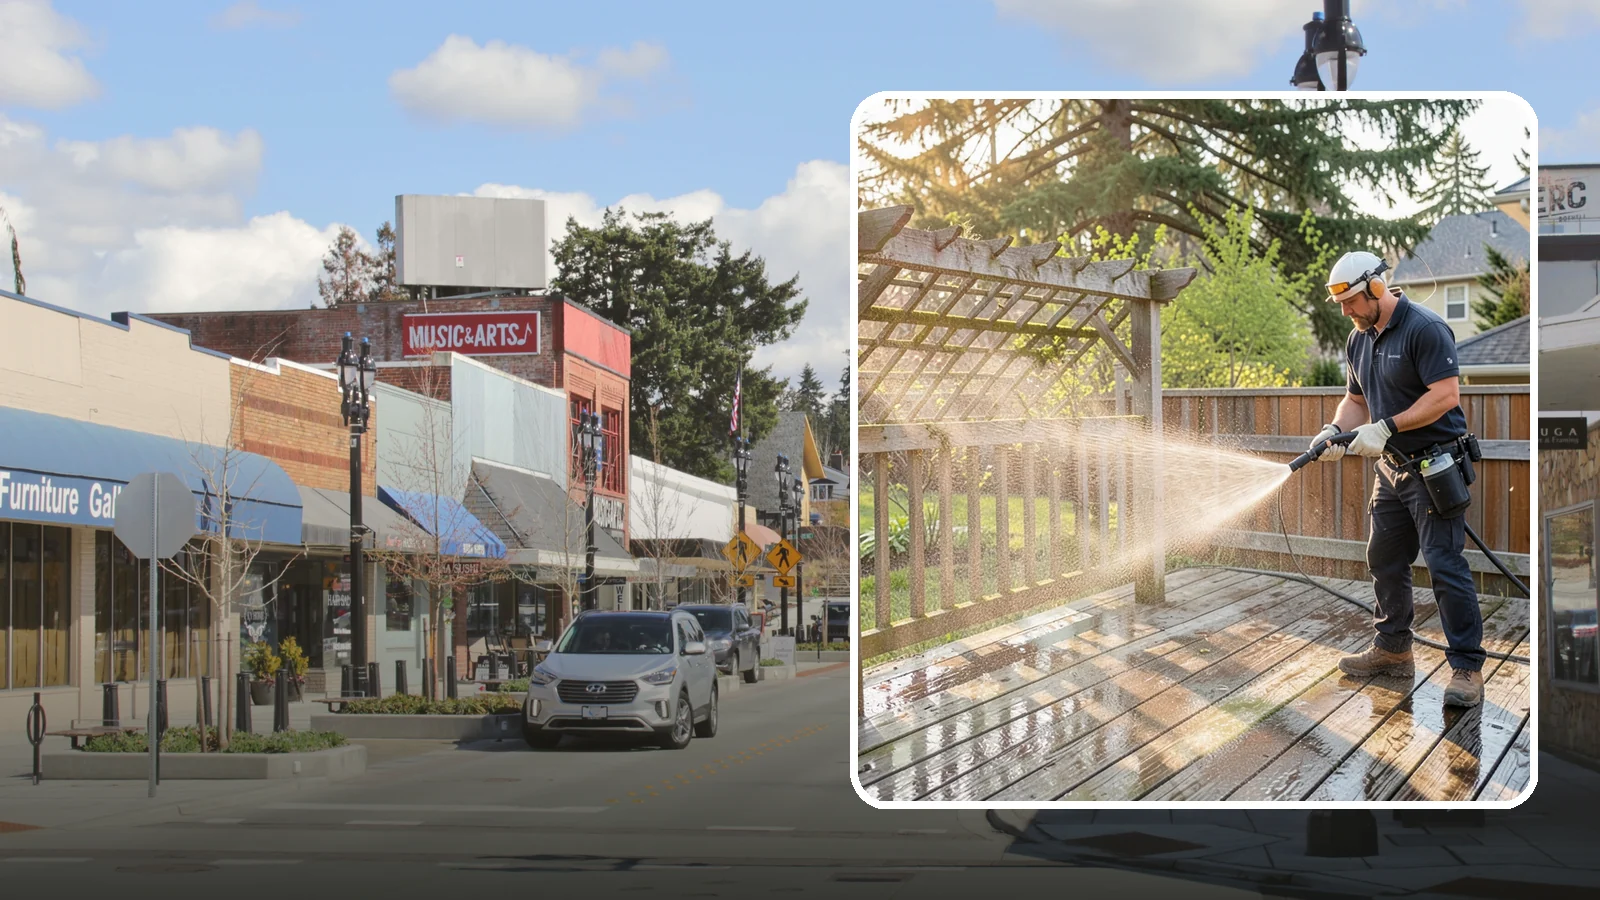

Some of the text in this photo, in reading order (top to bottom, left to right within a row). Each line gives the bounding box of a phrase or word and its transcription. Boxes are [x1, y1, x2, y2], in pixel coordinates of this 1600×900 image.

[0, 471, 121, 519] Furniture Gal
[453, 563, 479, 574] SUSHI
